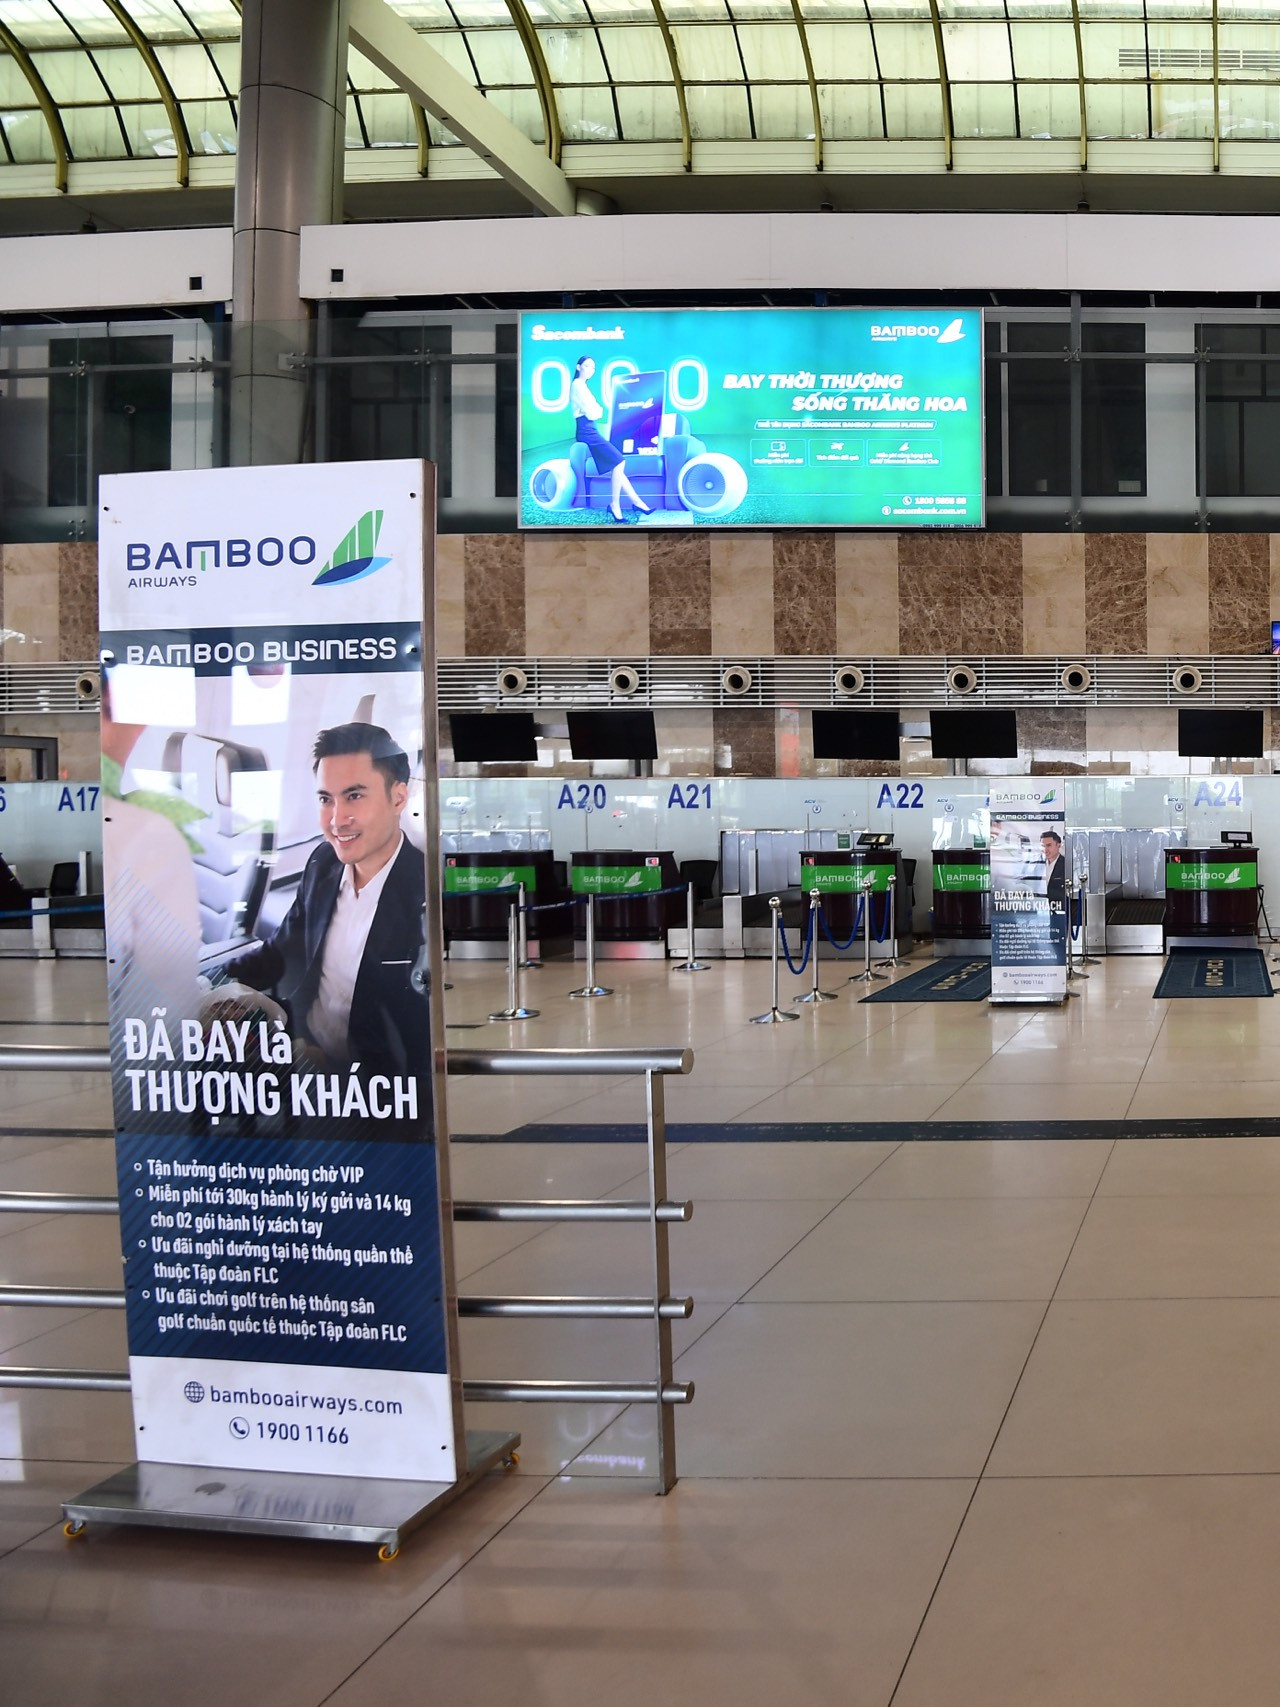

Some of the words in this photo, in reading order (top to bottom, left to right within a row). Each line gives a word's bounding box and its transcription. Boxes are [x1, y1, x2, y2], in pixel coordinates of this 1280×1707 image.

[871, 325, 940, 337] BAMBOO
[723, 373, 765, 389] BAY
[768, 370, 815, 389] THỜI
[819, 370, 903, 393] THƯỢNG
[792, 391, 848, 412] SỐNG
[852, 392, 920, 412] THĂNG
[924, 396, 968, 412] HOA
[127, 535, 316, 571] BAMBOO
[128, 575, 198, 589] AIRWAYS
[126, 641, 255, 666] BAMBOO
[263, 637, 397, 662] BUSINESS
[557, 784, 607, 810] A20
[667, 784, 712, 809] A21
[876, 783, 924, 809] A22
[1194, 782, 1242, 807] A24
[456, 876, 499, 885] BAMBOO
[583, 875, 625, 884] BAMBOO
[1181, 873, 1226, 881] BAMBOO
[994, 888, 1006, 900] ĐÃ
[1008, 890, 1024, 900] BAY
[994, 901, 1031, 913] THƯỢNG
[123, 1007, 175, 1061] ĐÃ
[181, 1019, 252, 1064] BAY
[259, 1020, 292, 1065] là
[125, 1069, 281, 1125] THƯỢNG
[291, 1062, 418, 1120] KHÁCH
[147, 1159, 172, 1180] Tận
[174, 1159, 216, 1183] hưởng
[218, 1163, 246, 1183] dịch
[249, 1167, 265, 1185] vụ
[268, 1166, 310, 1186] phòng
[312, 1164, 338, 1183] chờ
[340, 1166, 364, 1183] VIP
[148, 1183, 180, 1203] Miễn
[183, 1186, 203, 1207] phí
[205, 1187, 224, 1204] tới
[226, 1188, 259, 1210] 30kg
[261, 1190, 294, 1208] hành
[296, 1190, 310, 1212] lý
[312, 1191, 328, 1213] ký
[331, 1190, 353, 1214] gửi
[356, 1193, 372, 1210] và
[375, 1194, 392, 1211] 14
[394, 1195, 411, 1216] kg
[151, 1211, 174, 1228] cho
[176, 1212, 192, 1229] 02
[195, 1213, 215, 1233] gói
[217, 1213, 250, 1231] hành
[253, 1214, 266, 1236] lý
[267, 1216, 298, 1234] xách
[301, 1219, 323, 1239] tay
[154, 1263, 191, 1283] thuộc
[193, 1263, 216, 1284] Tập
[219, 1265, 251, 1282] đoàn
[253, 1267, 279, 1284] FLC
[155, 1287, 175, 1304] Ưu
[177, 1288, 197, 1305] đãi
[199, 1289, 228, 1306] chơi
[231, 1291, 257, 1311] golf
[259, 1292, 287, 1309] trên
[289, 1294, 307, 1314] hệ
[309, 1292, 348, 1317] thống
[351, 1297, 375, 1314] sân
[158, 1313, 185, 1332] golf
[187, 1312, 226, 1332] chuẩn
[229, 1315, 261, 1336] quốc
[263, 1315, 277, 1333] tế
[279, 1319, 317, 1338] thuộc
[318, 1320, 343, 1342] Tập
[346, 1323, 379, 1340] đoàn
[381, 1324, 407, 1341] FLC
[210, 1384, 403, 1416] bambooairways.com
[256, 1421, 300, 1442] 1900
[305, 1423, 349, 1445] 1166
